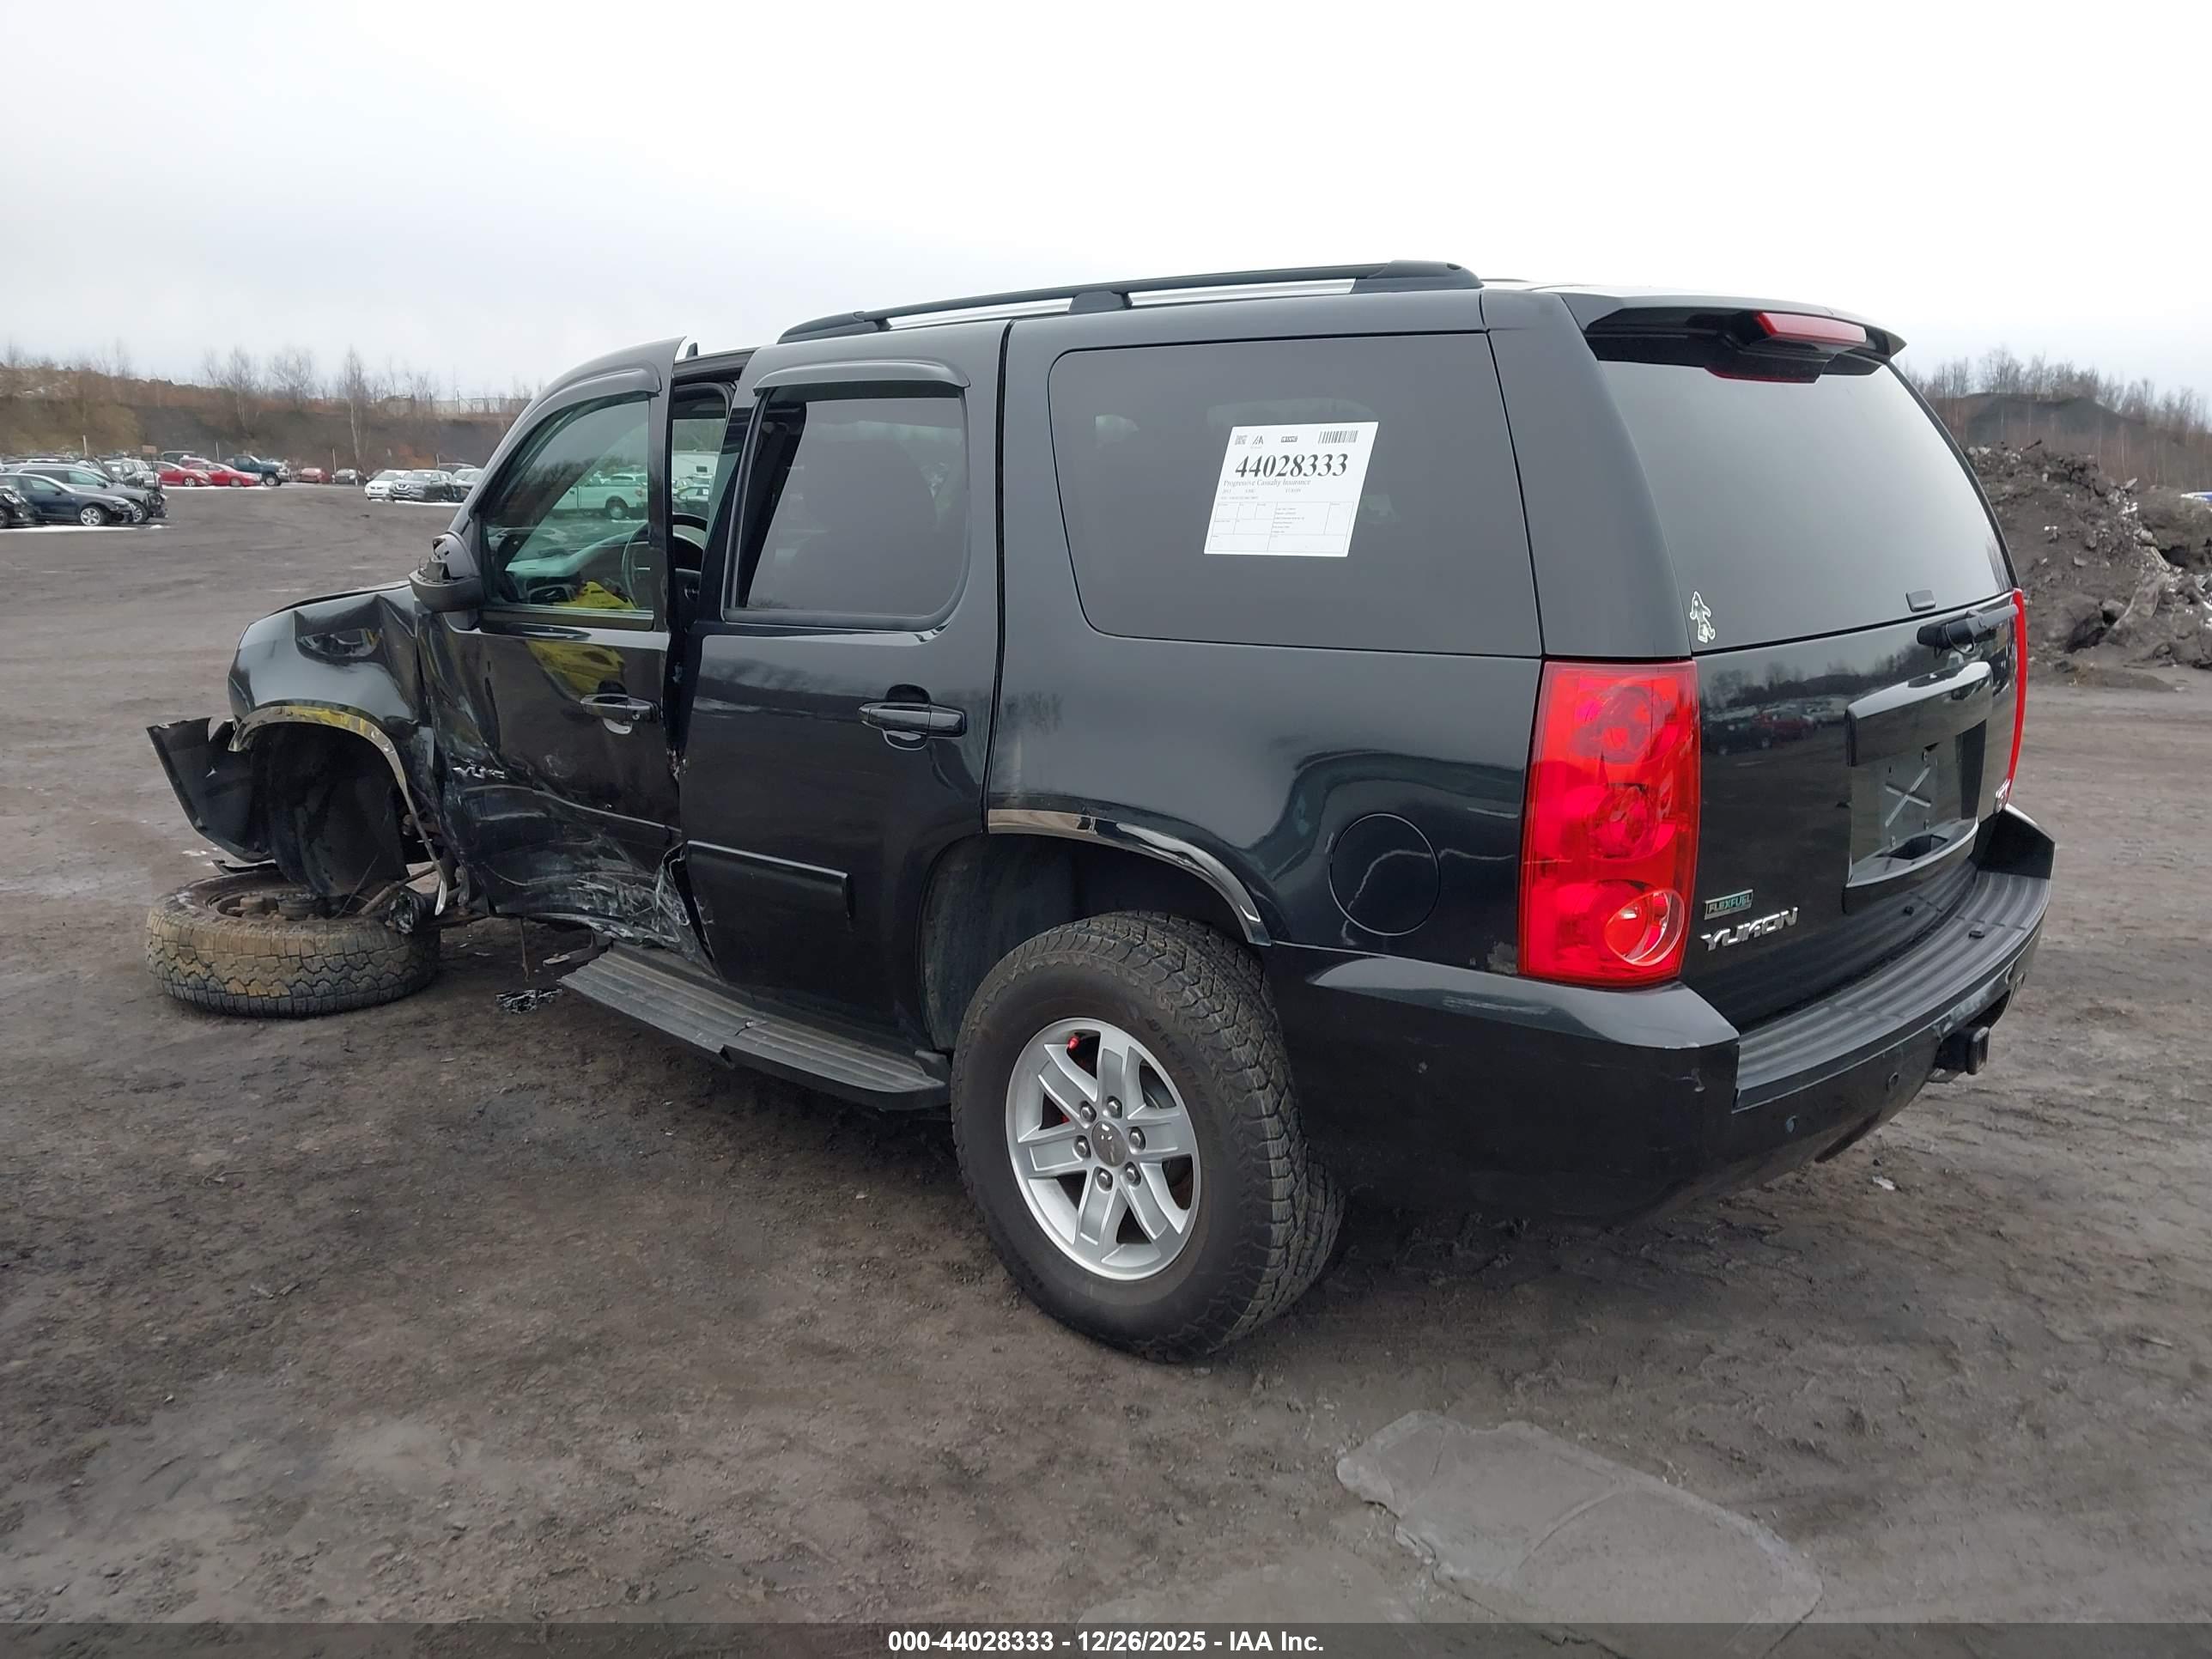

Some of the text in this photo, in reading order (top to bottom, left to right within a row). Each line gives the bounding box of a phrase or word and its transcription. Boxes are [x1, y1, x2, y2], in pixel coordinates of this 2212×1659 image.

[1235, 453, 1348, 477] 44028333
[1224, 479, 1255, 488] Progressive
[1256, 478, 1282, 488] Casualty
[1707, 894, 1752, 914] FLEXFUEL
[1700, 907, 1799, 951] YUKON
